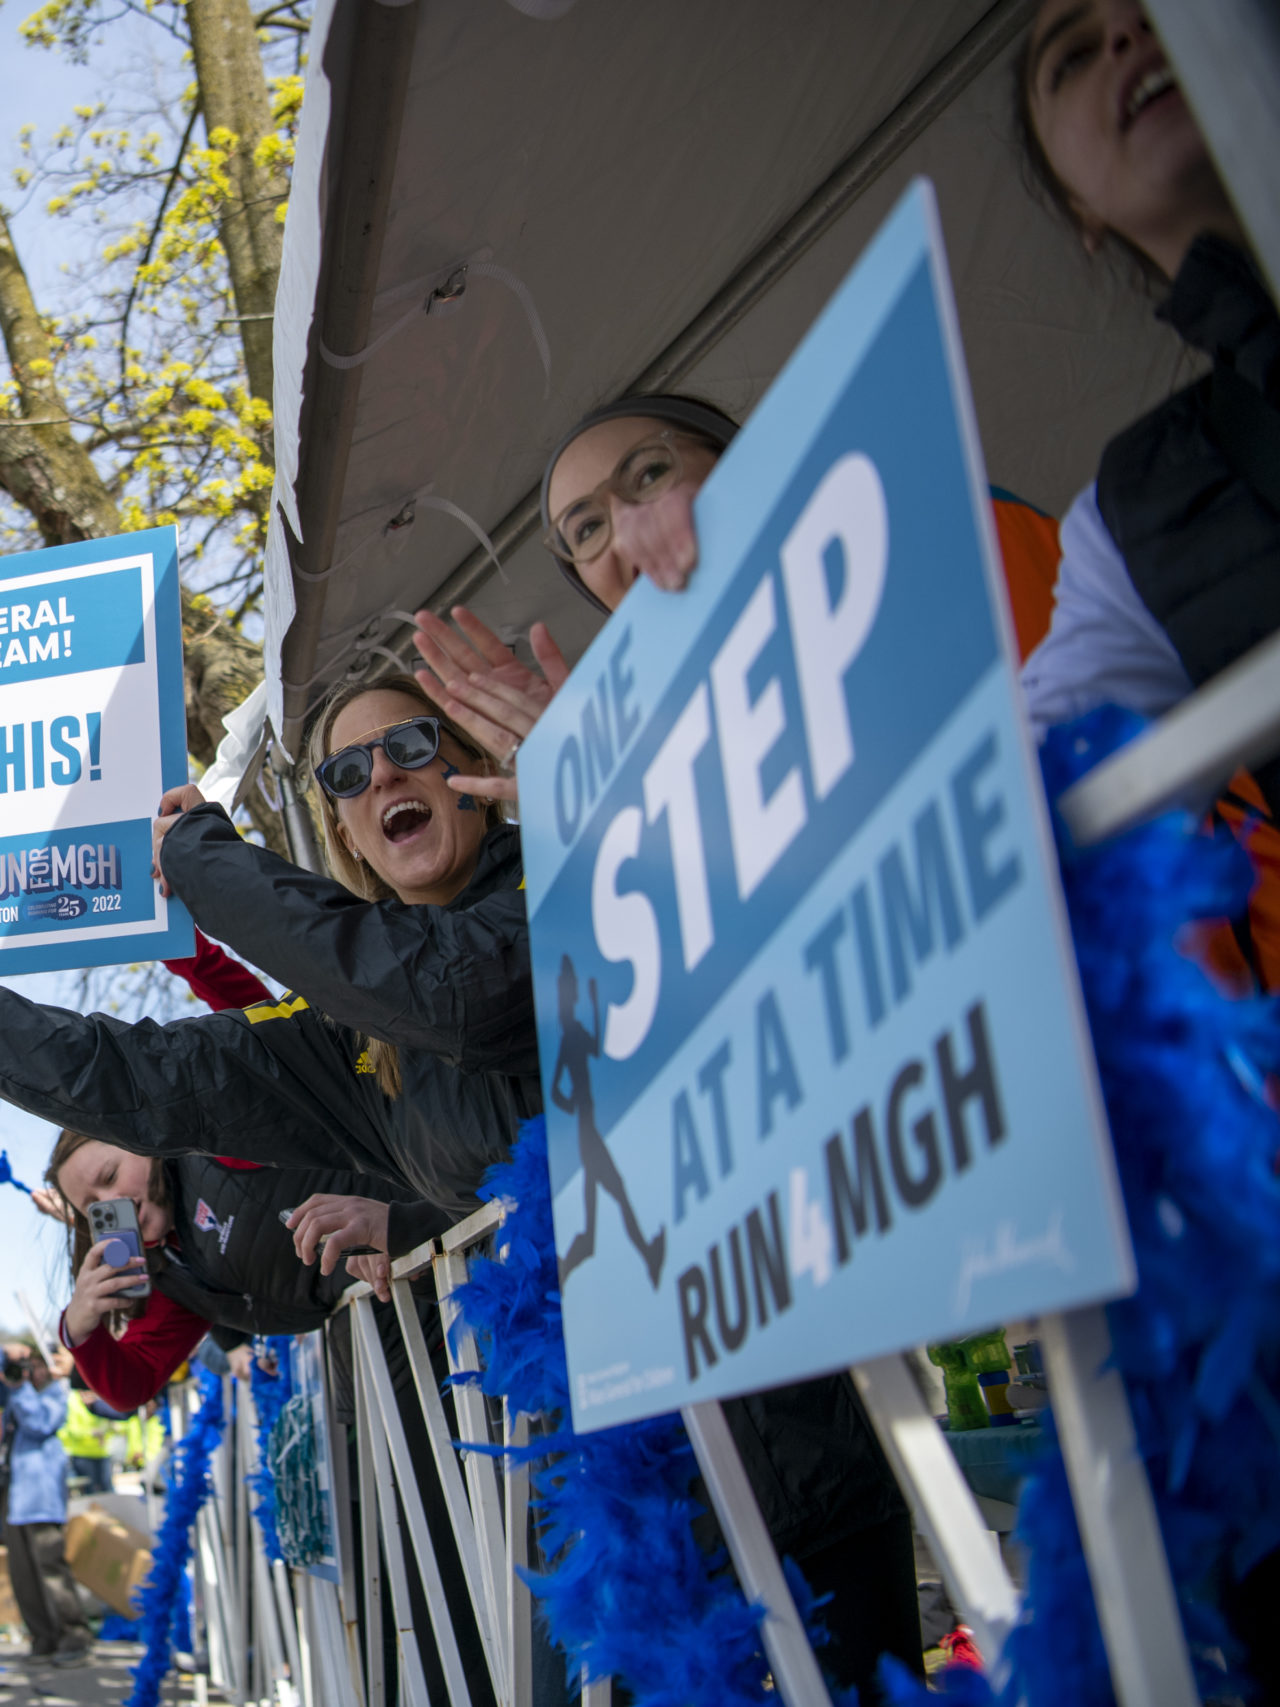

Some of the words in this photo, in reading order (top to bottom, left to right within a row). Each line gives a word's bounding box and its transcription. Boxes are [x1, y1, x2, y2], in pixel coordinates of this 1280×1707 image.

[554, 622, 643, 849] ONE
[591, 451, 888, 1061] STEP
[28, 846, 50, 889] FOR
[51, 843, 118, 887] MGH
[57, 896, 81, 917] 25
[92, 893, 122, 913] 2022
[670, 1034, 735, 1227] AT
[755, 985, 805, 1143] A
[802, 726, 1025, 1070] TIME
